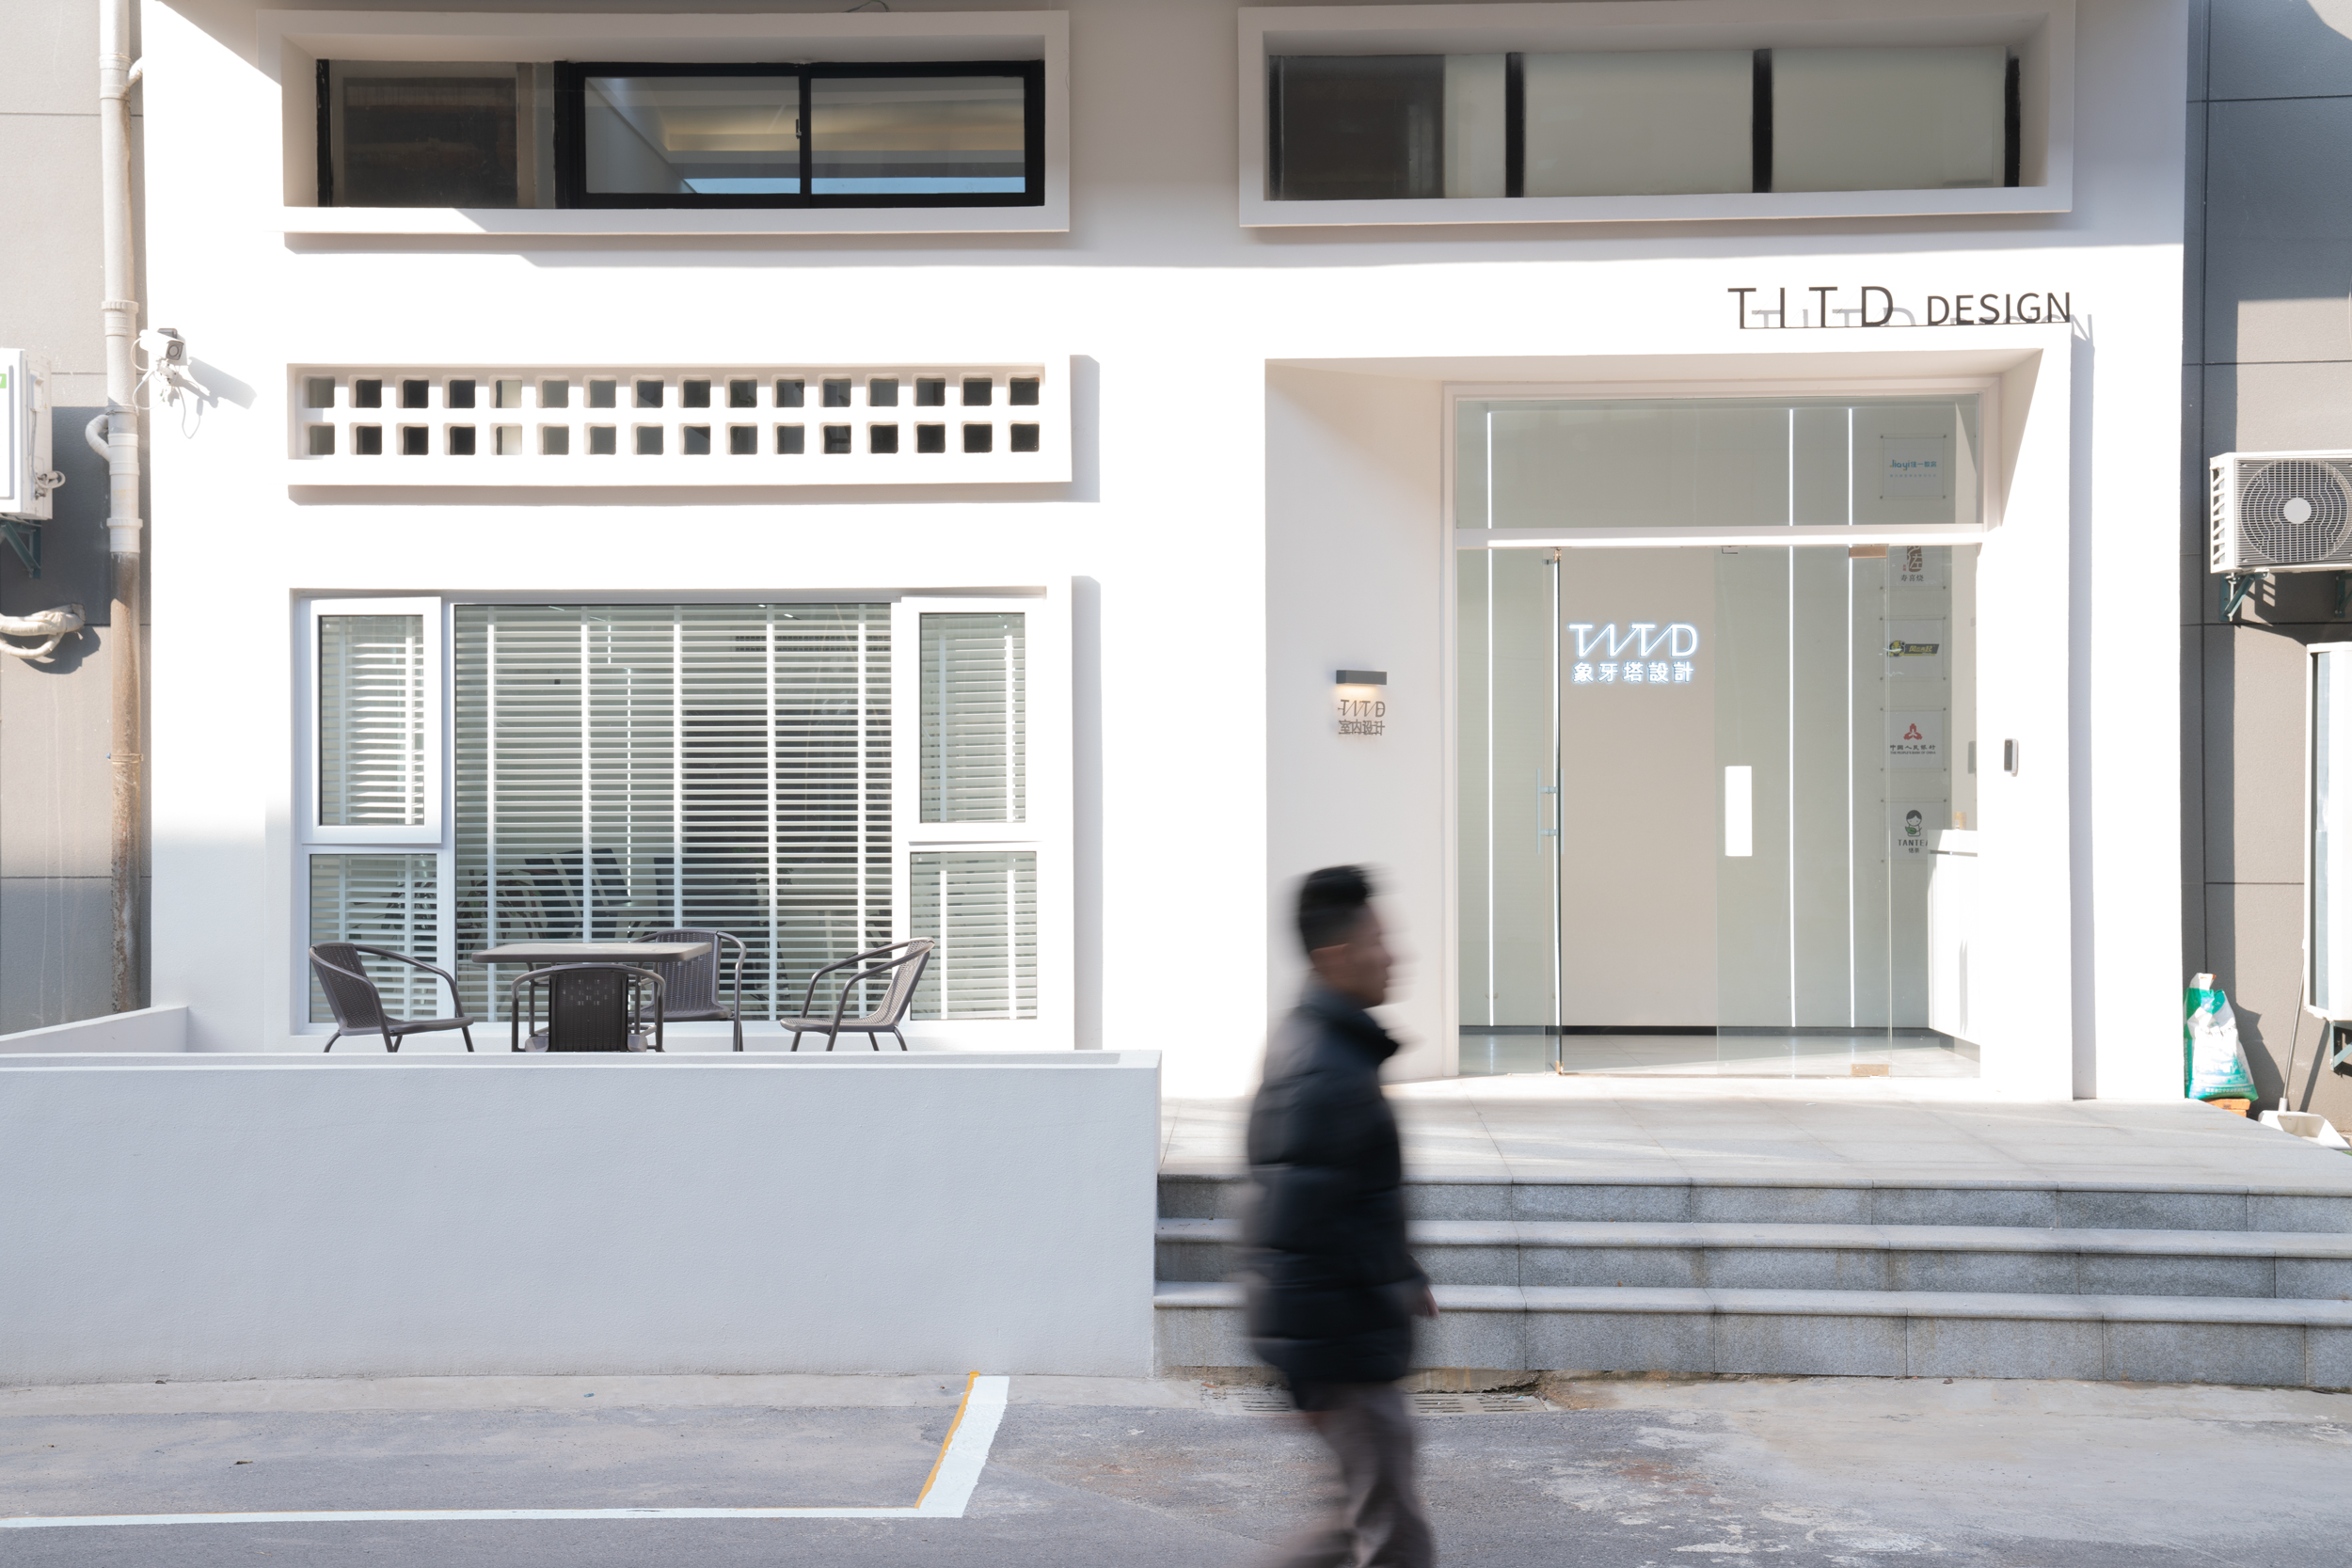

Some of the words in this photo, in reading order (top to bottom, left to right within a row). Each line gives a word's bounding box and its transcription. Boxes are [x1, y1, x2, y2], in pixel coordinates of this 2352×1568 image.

[1727, 285, 1894, 329] TITD
[1927, 292, 2071, 326] DESIGN
[1900, 574, 1925, 582] 寿喜烧
[1572, 661, 1694, 683] 象牙塔設計
[1338, 719, 1386, 736] 室内设计
